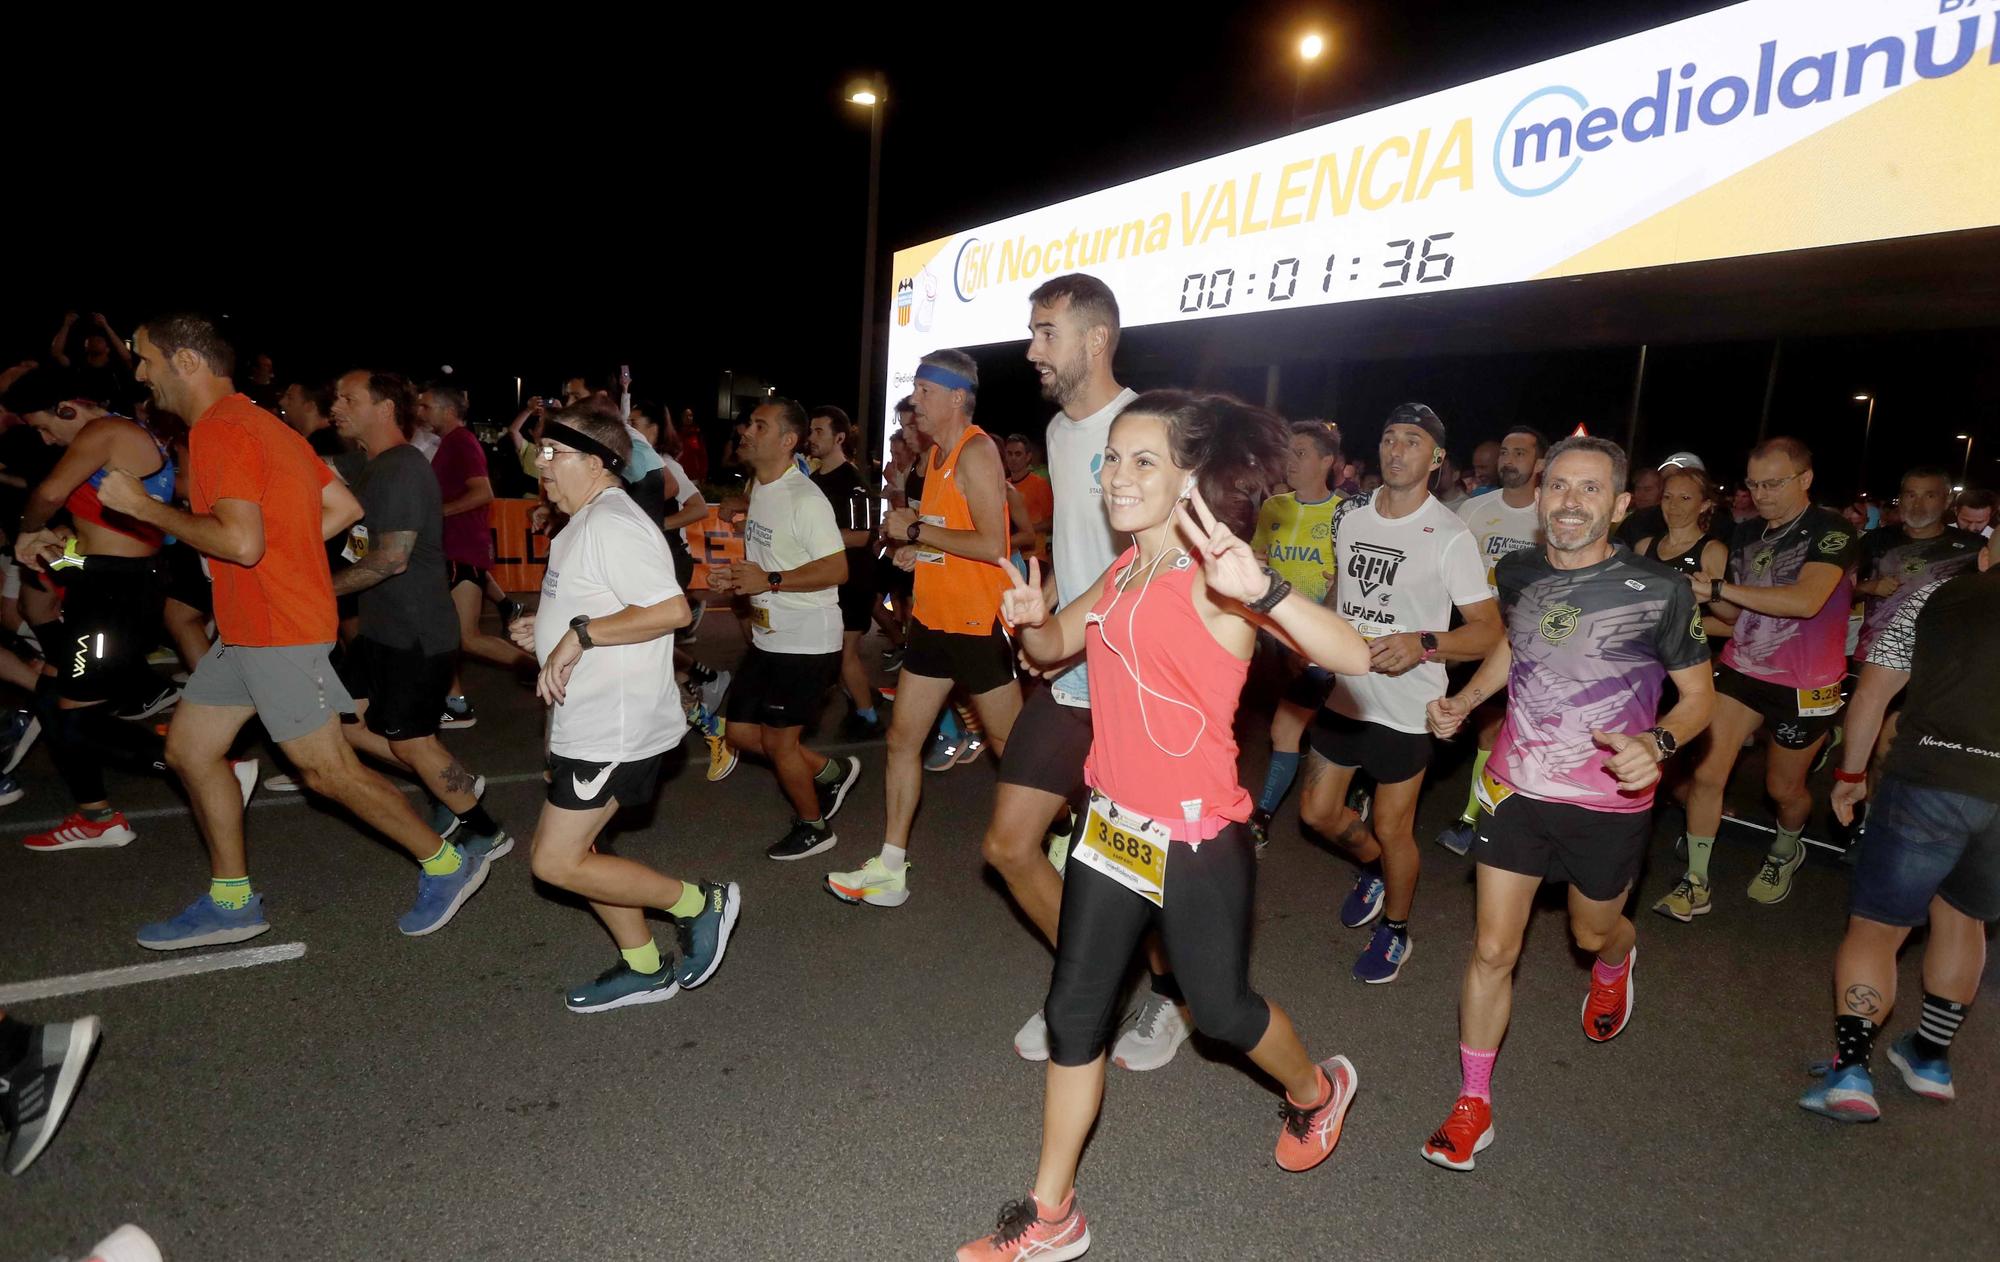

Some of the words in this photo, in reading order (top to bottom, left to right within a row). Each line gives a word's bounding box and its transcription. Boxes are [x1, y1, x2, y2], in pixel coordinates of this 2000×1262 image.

[962, 241, 995, 294] 15K
[996, 211, 1172, 284] Nocturna
[1181, 117, 1474, 247] VALENCIA
[1487, 536, 1510, 554] 15K
[1342, 601, 1396, 625] ALFAFAR
[1919, 735, 1963, 750] Nunca
[1098, 821, 1153, 866] 3.683
[713, 889, 722, 913] HOKA
